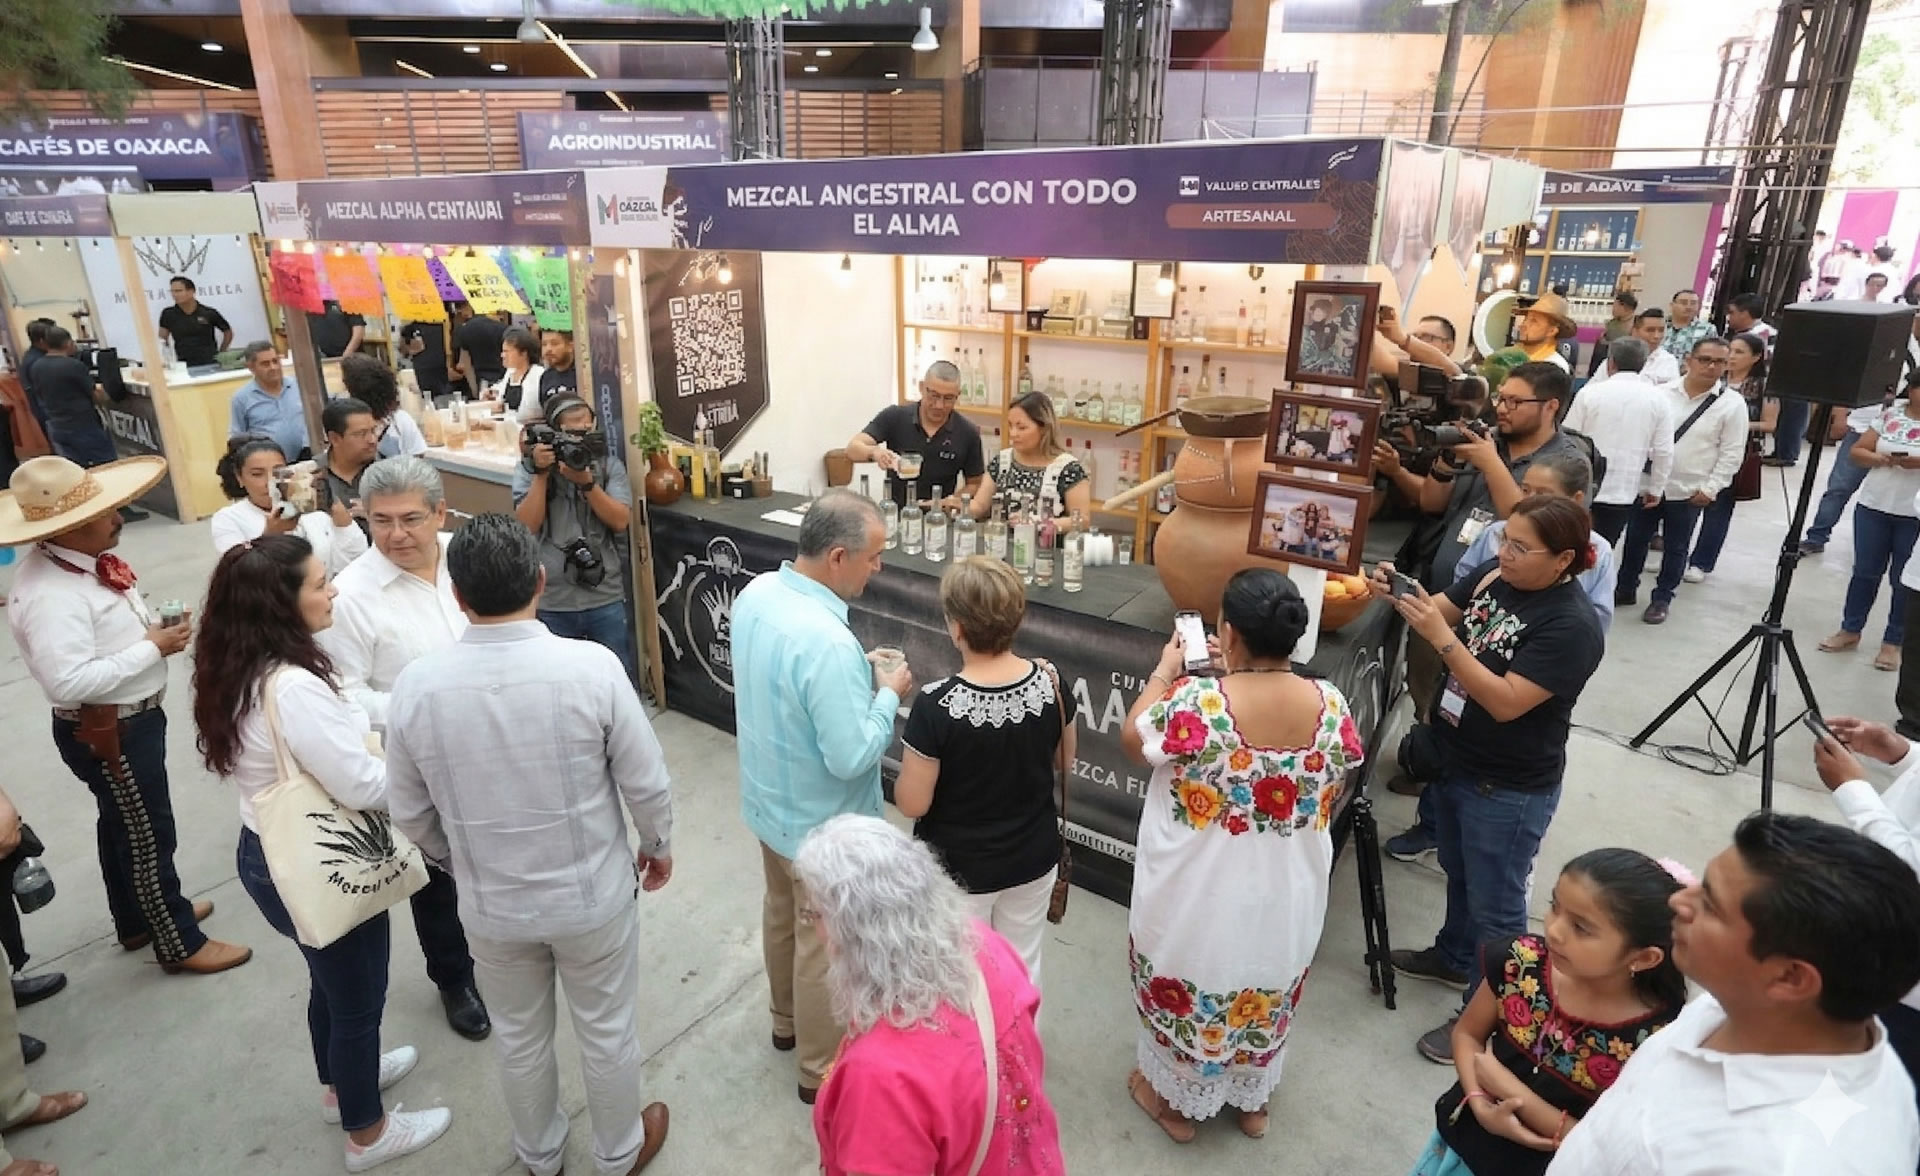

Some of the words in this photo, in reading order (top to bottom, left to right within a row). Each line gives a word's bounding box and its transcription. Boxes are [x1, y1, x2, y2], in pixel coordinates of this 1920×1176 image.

[0, 136, 72, 156] CAFÉS
[76, 139, 110, 155] DE
[114, 138, 212, 155] OAXACA
[549, 133, 717, 150] AGROINDUSTRIAL
[726, 187, 814, 208] MEZCAL
[819, 182, 964, 206] ANCESTRAL
[972, 181, 1034, 204] CON
[1042, 178, 1138, 205] TODO
[1560, 182, 1583, 194] DE
[325, 201, 378, 219] MEZCAL
[380, 201, 427, 219] ALPHA
[1202, 210, 1296, 222] ARTESANAL
[853, 215, 882, 235] EL
[886, 214, 960, 236] ALMA
